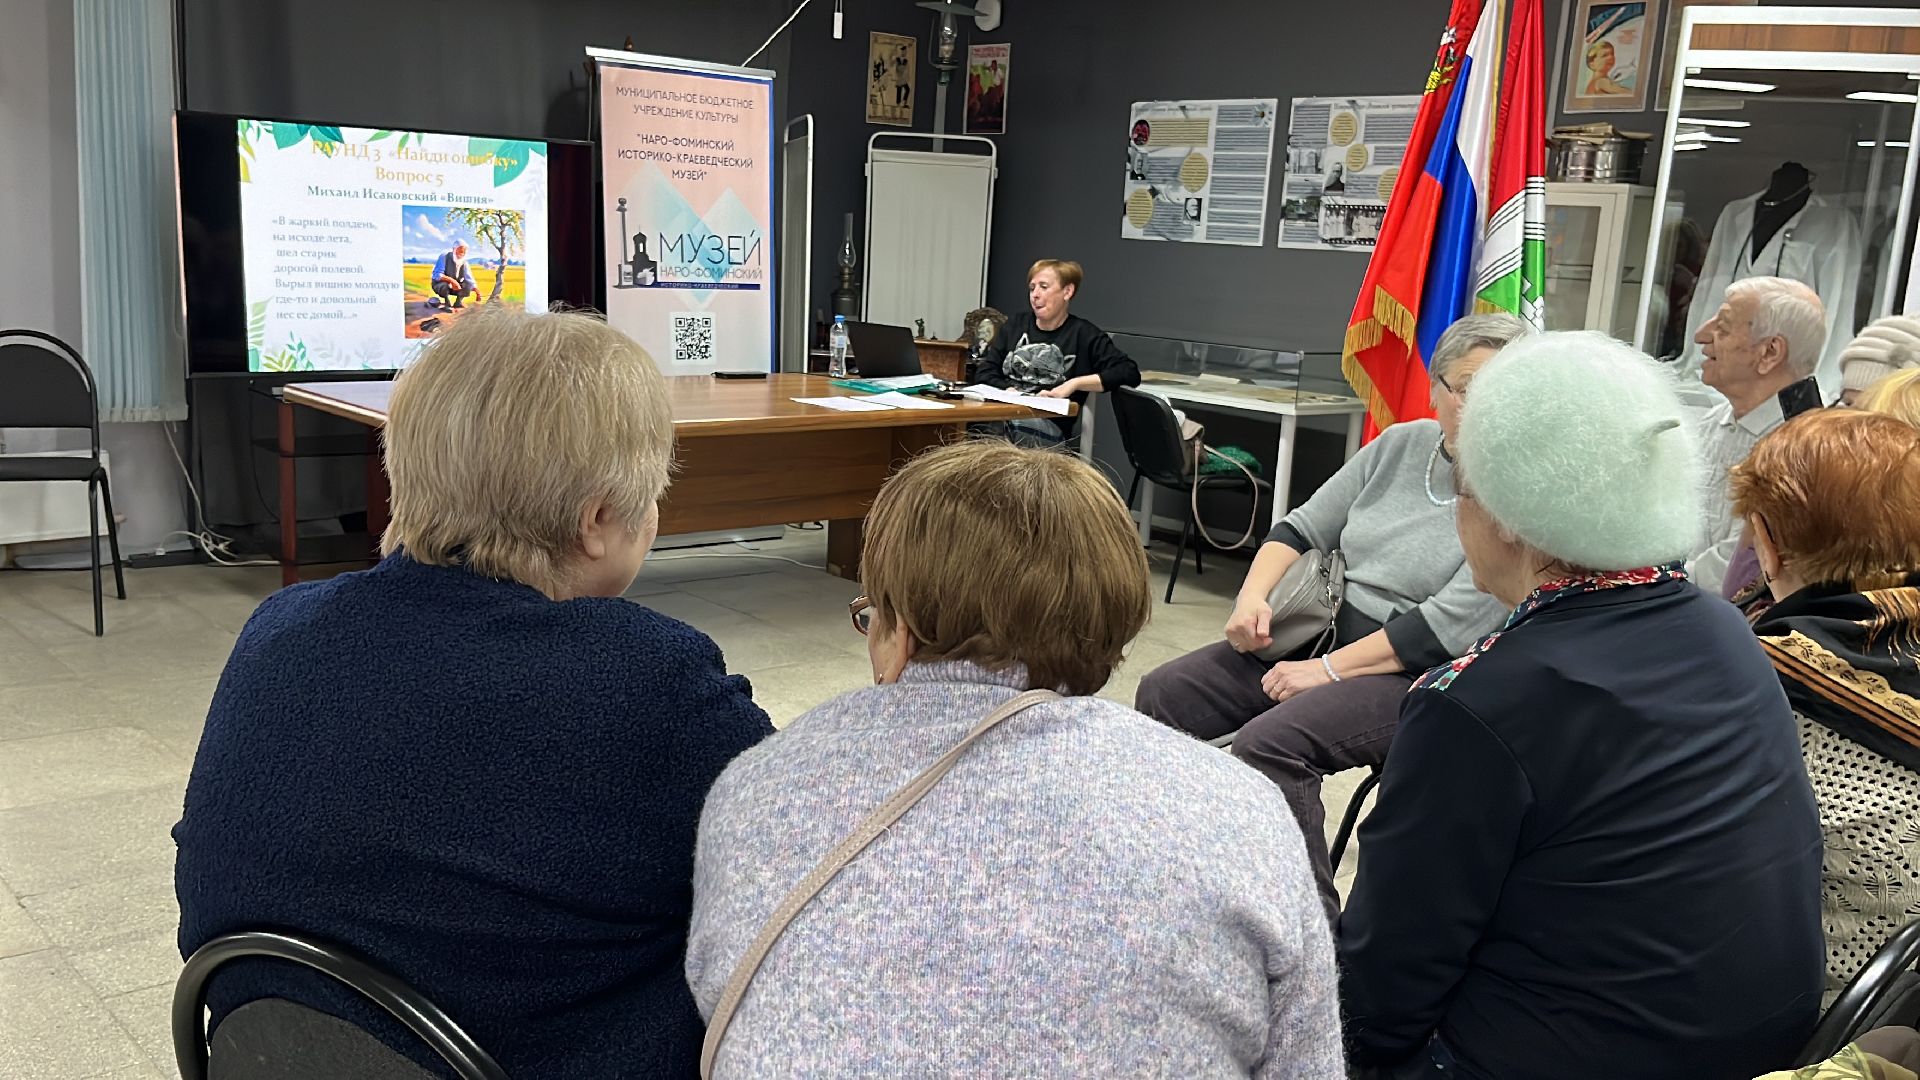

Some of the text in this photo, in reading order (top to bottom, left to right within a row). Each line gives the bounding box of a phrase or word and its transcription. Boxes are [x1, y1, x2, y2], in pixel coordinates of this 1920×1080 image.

[616, 86, 754, 110] МУНИЦИПАЛЬНОЕ БЮДЖЕТНОЕ
[634, 104, 738, 124] УЧРЕЖДЕНИЕ КУЛЬТУРЫ
[637, 134, 734, 151] "НАРО-ФОМИНСКИЙ
[312, 140, 518, 171] РАУНД 3 «Найди ошибку»
[618, 149, 754, 168] ИСТОРИКО-КРАЕВЕДЧЕСКИЙ
[375, 166, 444, 187] Вопрос 5
[672, 169, 708, 181] МУЗЕЙ"
[307, 185, 494, 204] Михаил Исаковский «Вишня»
[272, 216, 378, 230] «В жаркий полдень,
[288, 234, 325, 243] исходе
[300, 250, 337, 260] старик
[660, 229, 761, 266] МУЗЕЙ
[274, 264, 318, 275] дорогой
[660, 266, 762, 280] НАРО-ФОМИНСКИЙ
[276, 278, 400, 292] Вырыл вишню молодую
[276, 296, 308, 305] где-то
[320, 296, 376, 305] довольный
